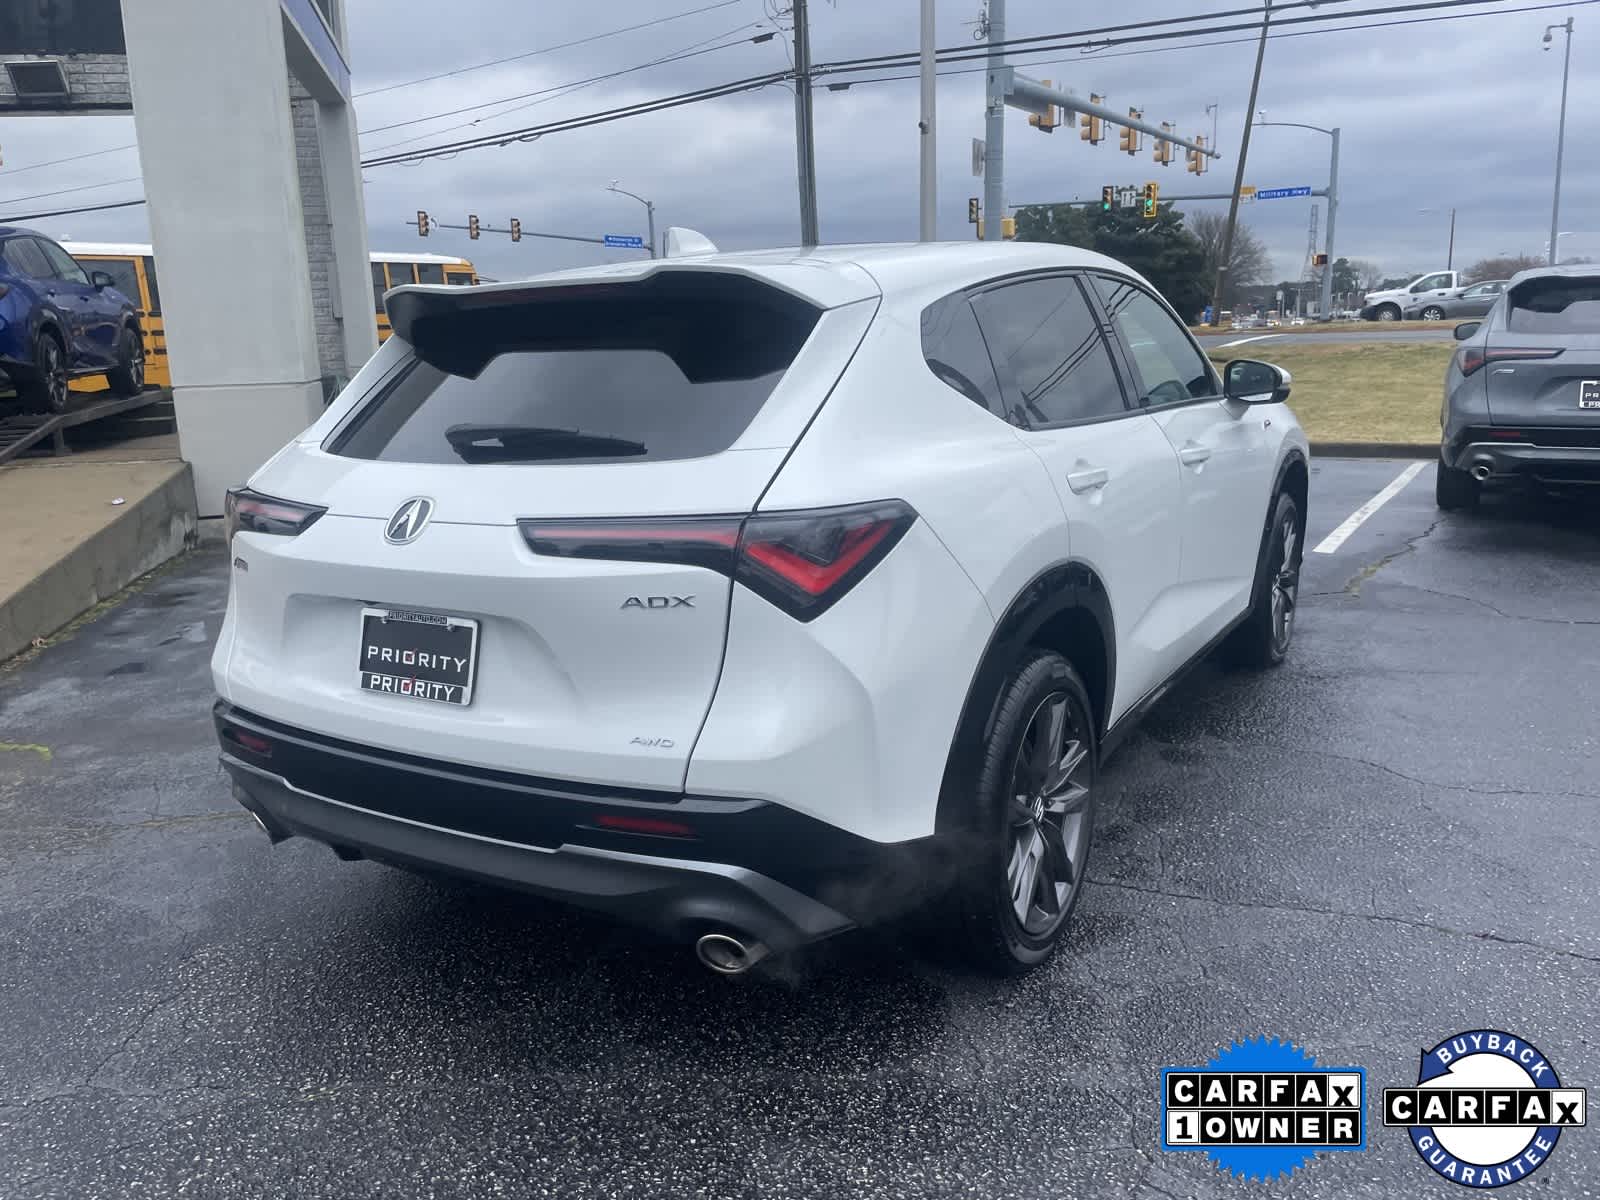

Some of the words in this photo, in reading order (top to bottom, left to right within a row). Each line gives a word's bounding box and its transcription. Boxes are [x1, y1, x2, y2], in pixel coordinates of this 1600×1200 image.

[1260, 190, 1289, 199] Military
[619, 594, 697, 610] ADX
[367, 645, 467, 673] PRIORITY
[370, 674, 455, 701] PRIORITY
[629, 736, 676, 749] AWD
